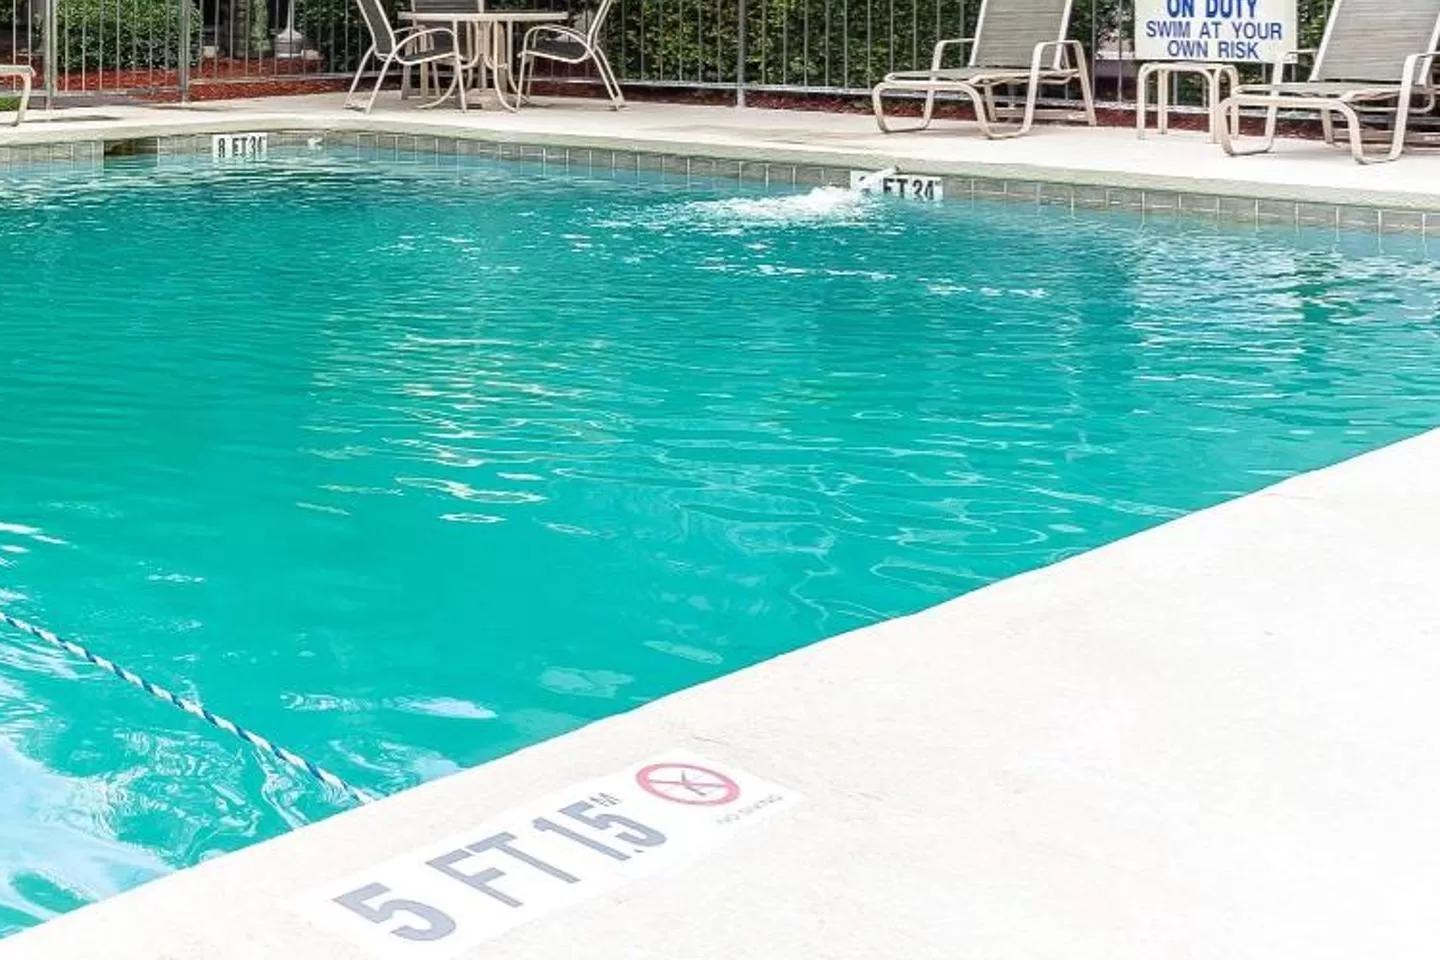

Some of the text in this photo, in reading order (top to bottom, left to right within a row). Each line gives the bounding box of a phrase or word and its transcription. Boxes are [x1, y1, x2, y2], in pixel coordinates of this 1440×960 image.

[1146, 21, 1282, 40] SWIM AT YOUR
[1167, 40, 1259, 59] OWN RISK
[883, 177, 908, 198] FT
[332, 882, 456, 942] 5
[425, 831, 581, 908] FT
